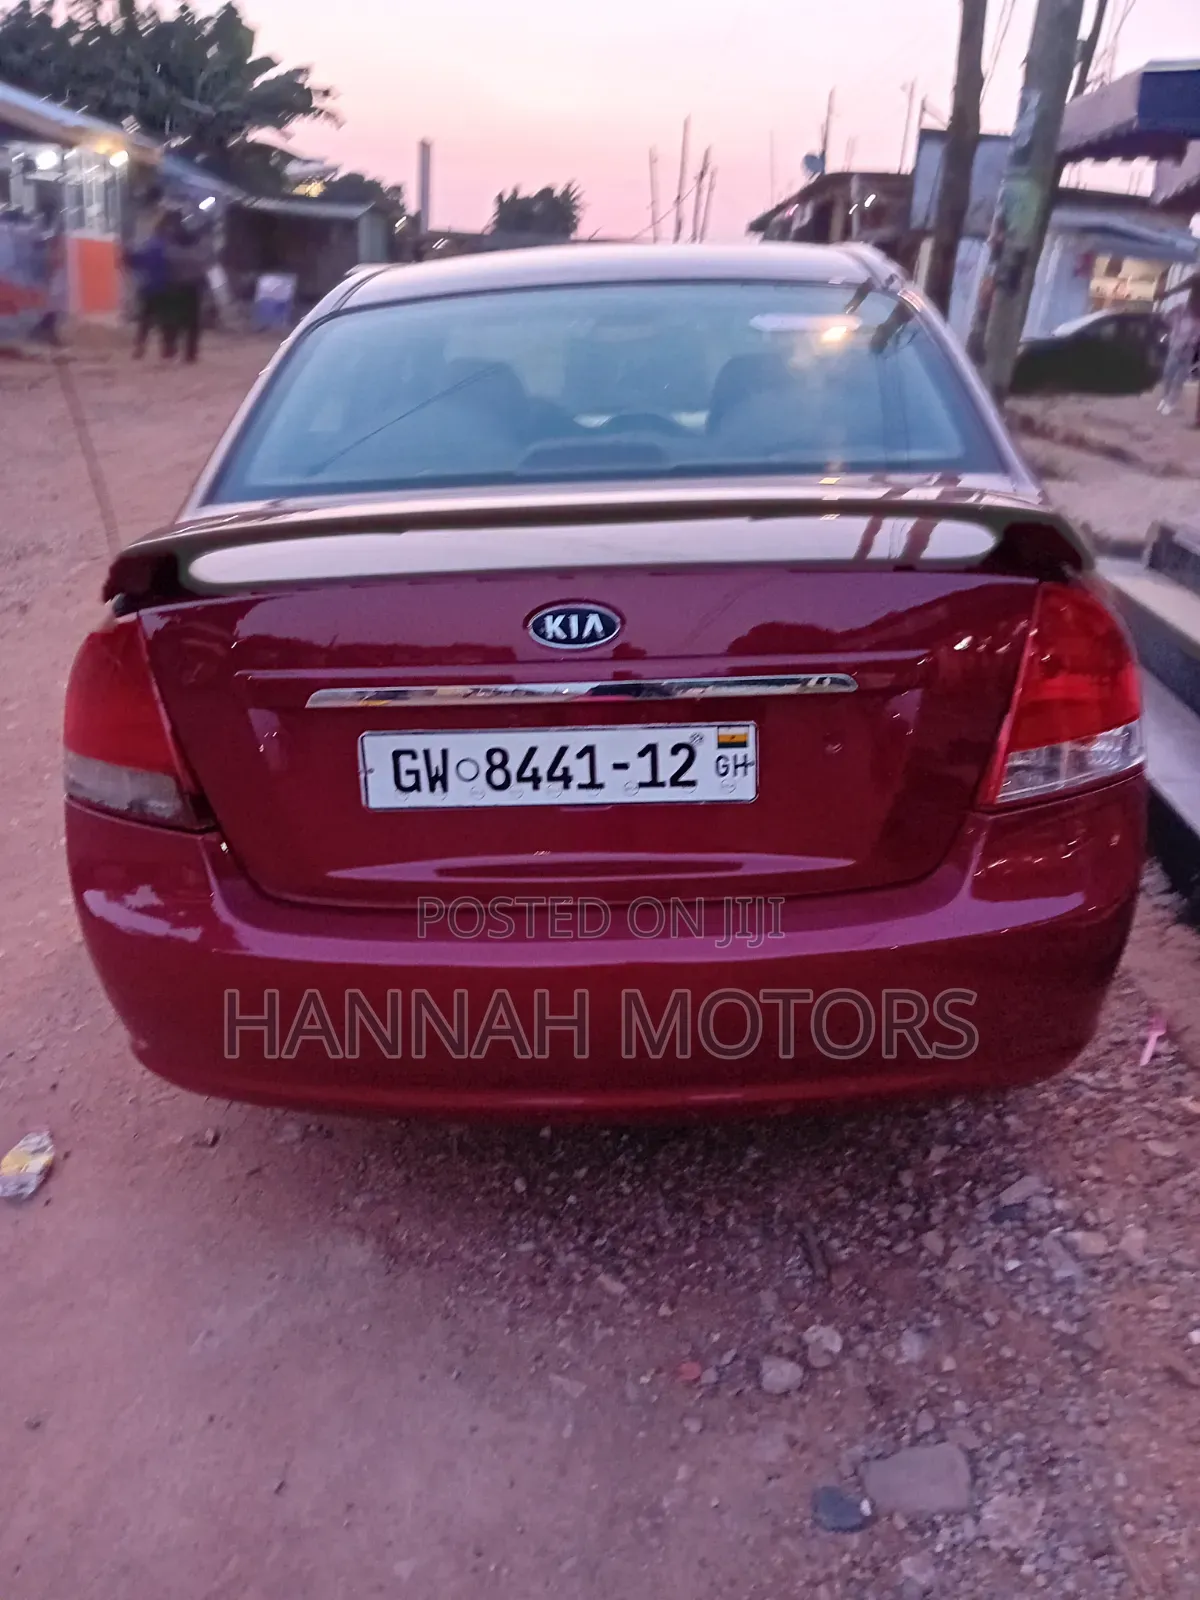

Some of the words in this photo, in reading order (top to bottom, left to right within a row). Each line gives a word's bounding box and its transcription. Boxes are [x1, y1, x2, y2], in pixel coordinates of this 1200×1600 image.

[543, 613, 605, 640] KIA
[391, 747, 450, 793] GW
[485, 742, 698, 792] 8441-12
[715, 753, 750, 778] GH
